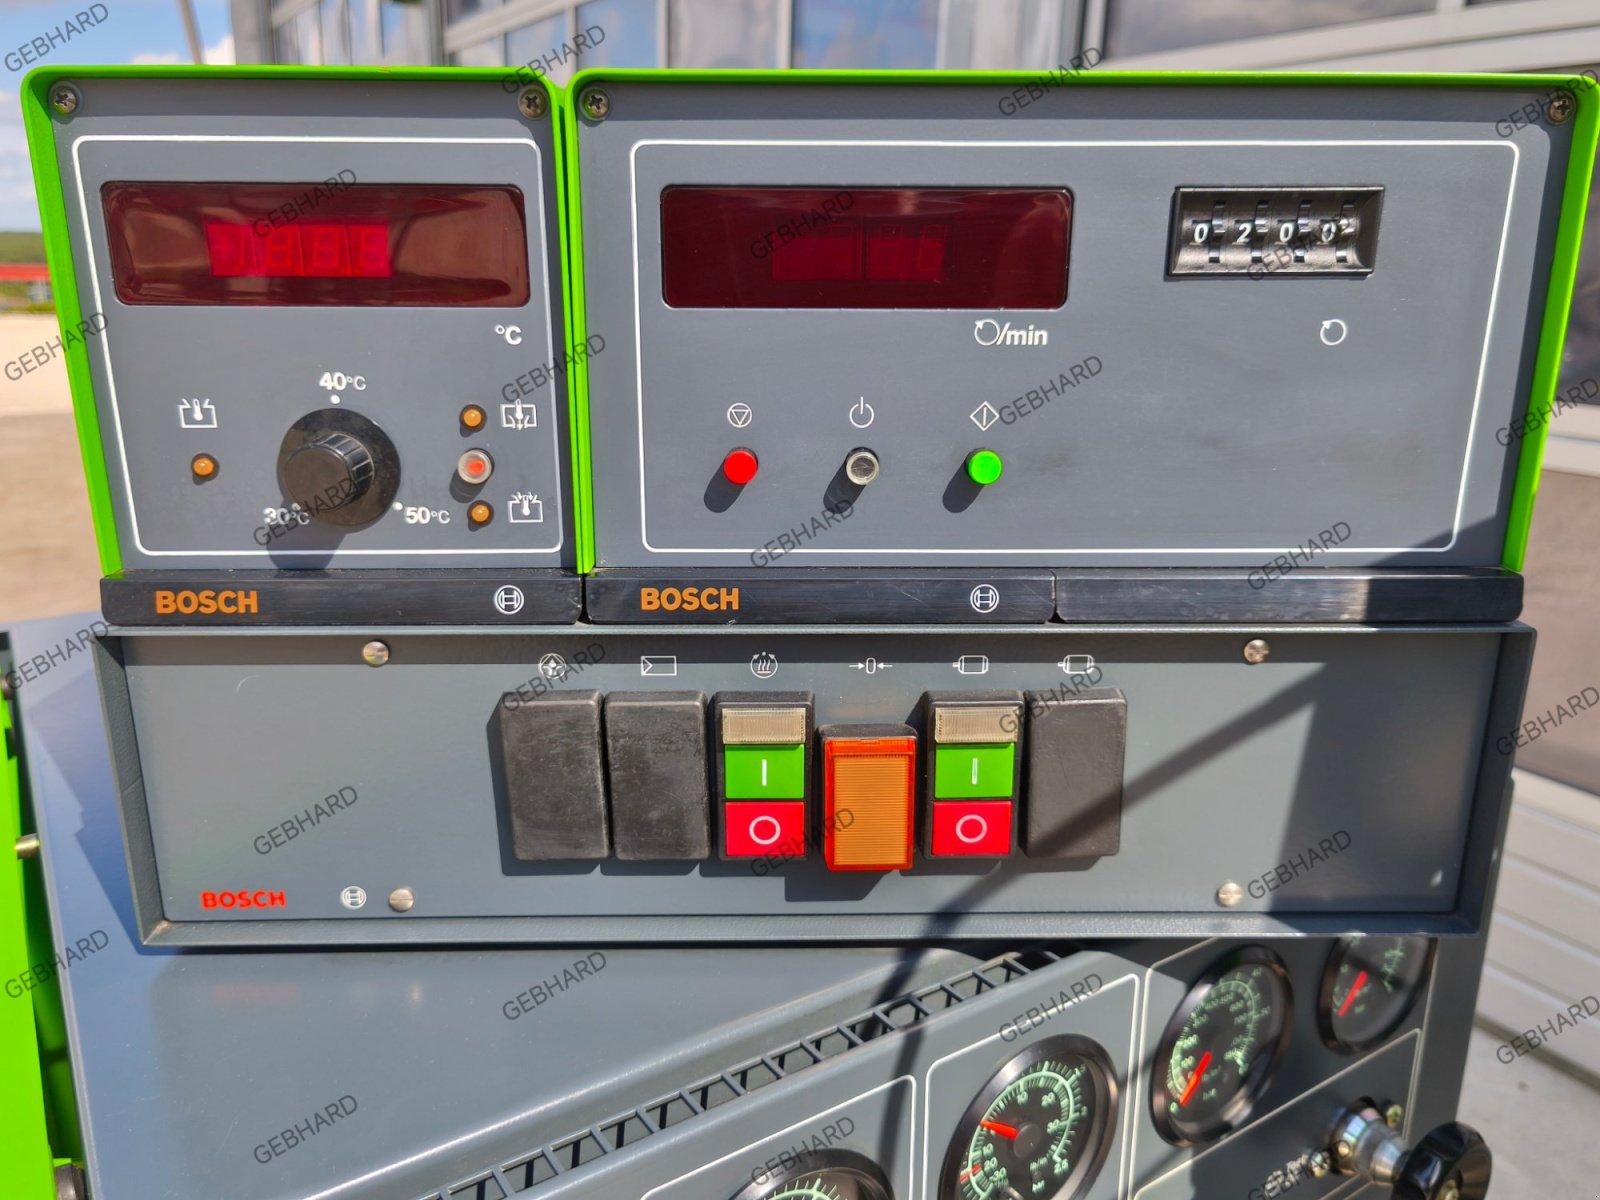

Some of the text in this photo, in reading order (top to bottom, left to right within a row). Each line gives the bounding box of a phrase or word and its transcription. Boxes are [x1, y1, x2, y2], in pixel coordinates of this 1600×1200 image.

[494, 324, 522, 345] °C
[319, 372, 367, 391] 40°C
[404, 507, 450, 524] 50°C
[155, 590, 258, 614] BOSCH
[640, 587, 739, 611] BOSCH
[201, 890, 286, 909] BOSCH
